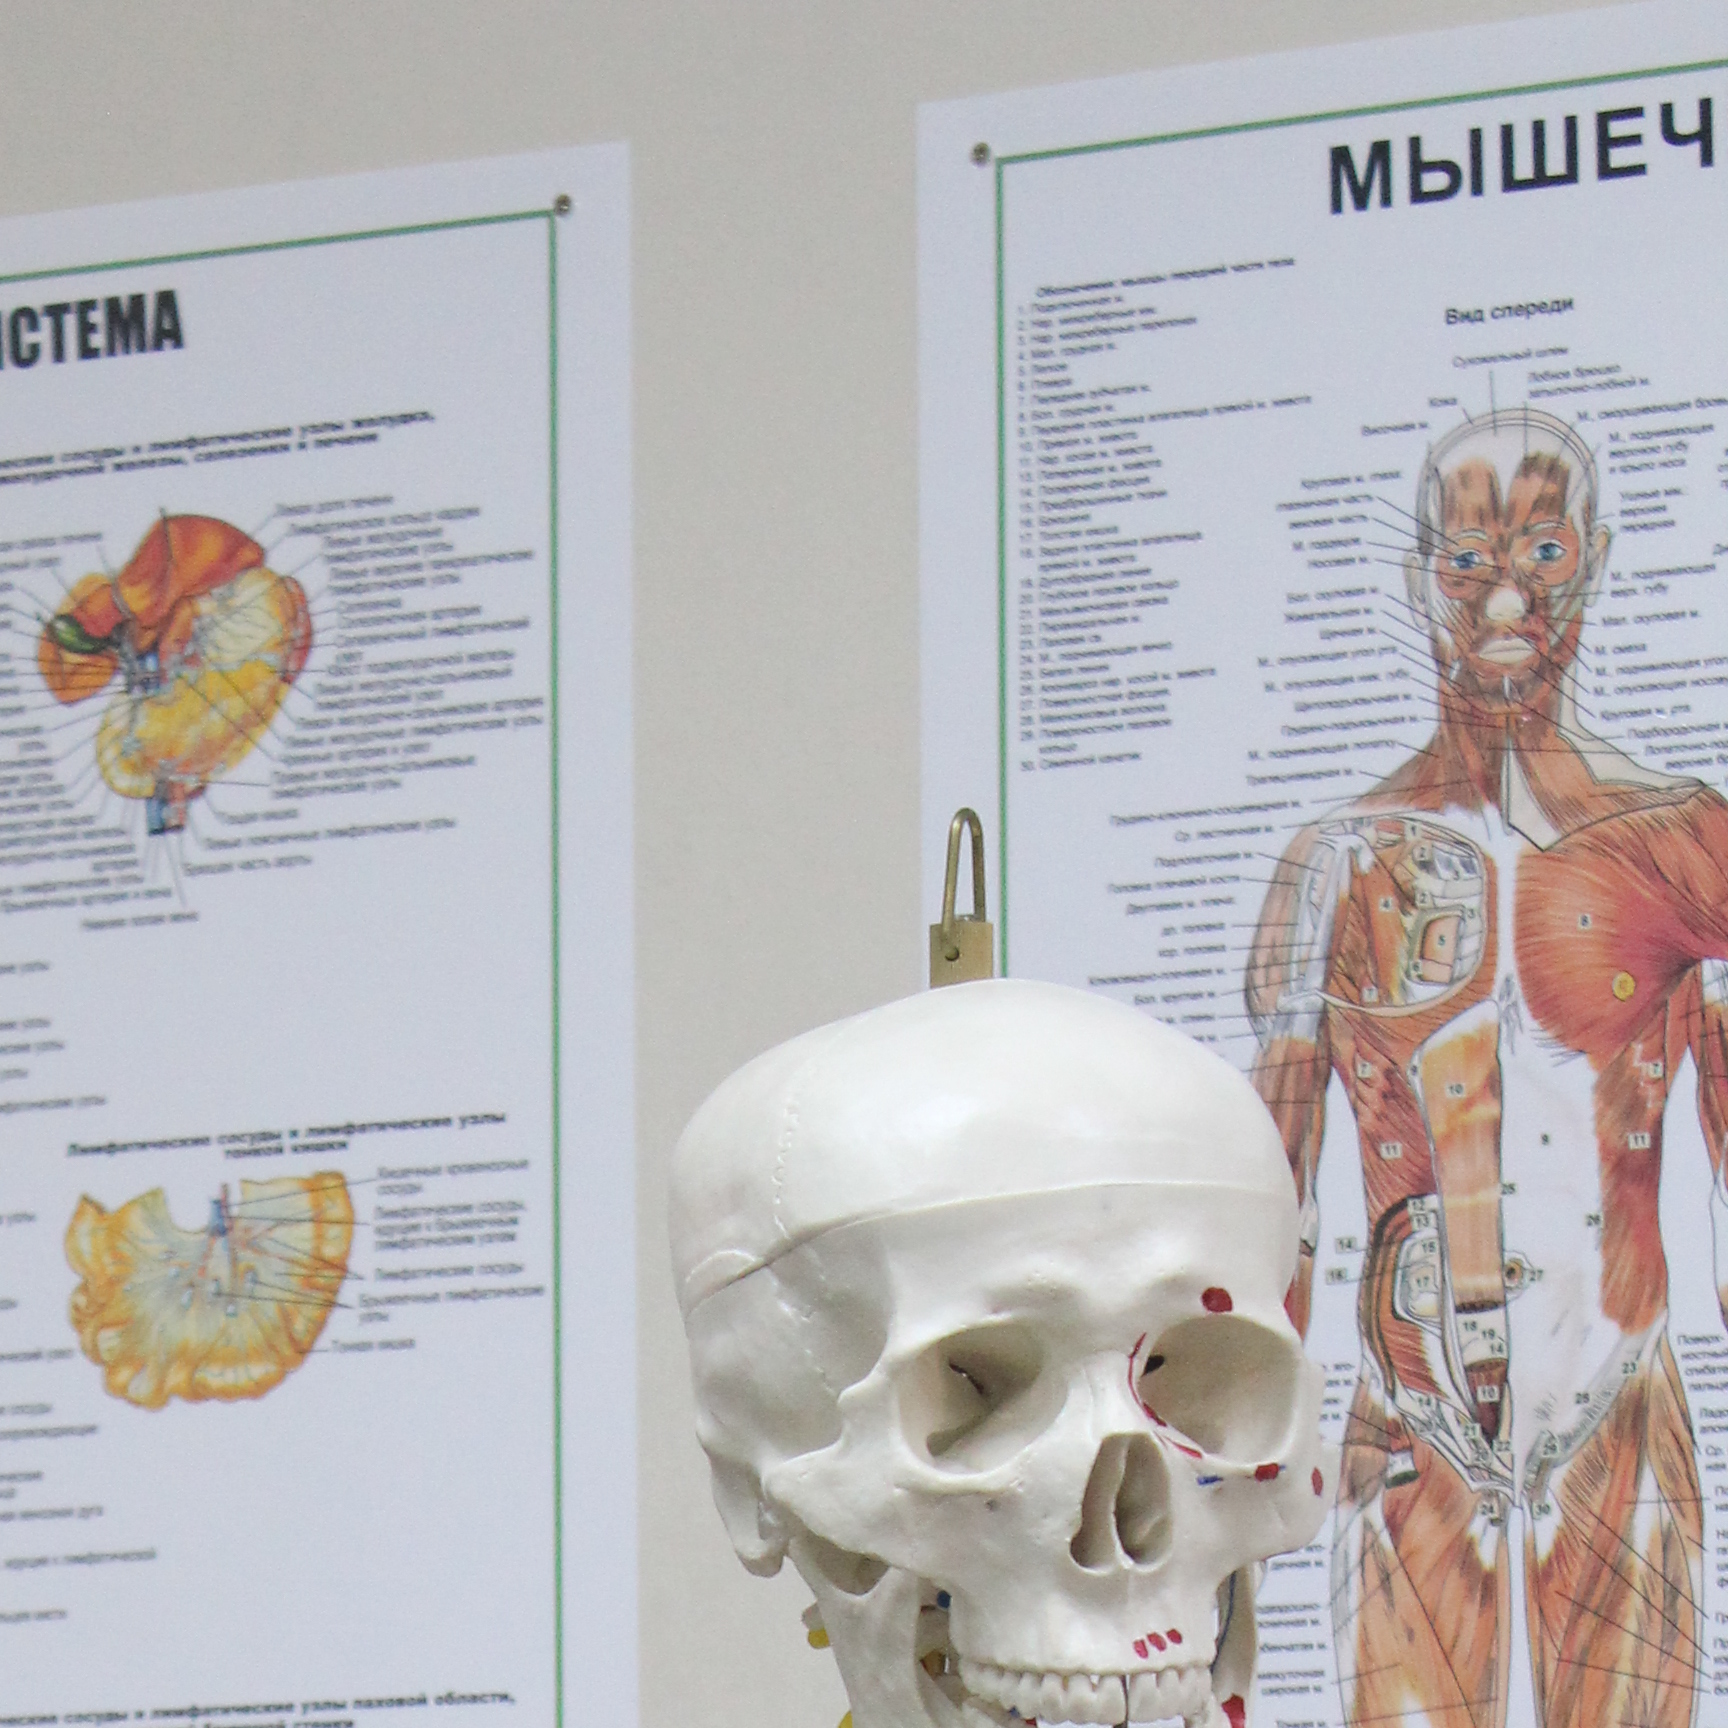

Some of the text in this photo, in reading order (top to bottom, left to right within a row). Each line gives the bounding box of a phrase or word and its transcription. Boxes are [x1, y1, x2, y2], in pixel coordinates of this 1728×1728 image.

[1328, 97, 1715, 214] МЫШЕЧ
[1445, 297, 1575, 325] Вид спереди
